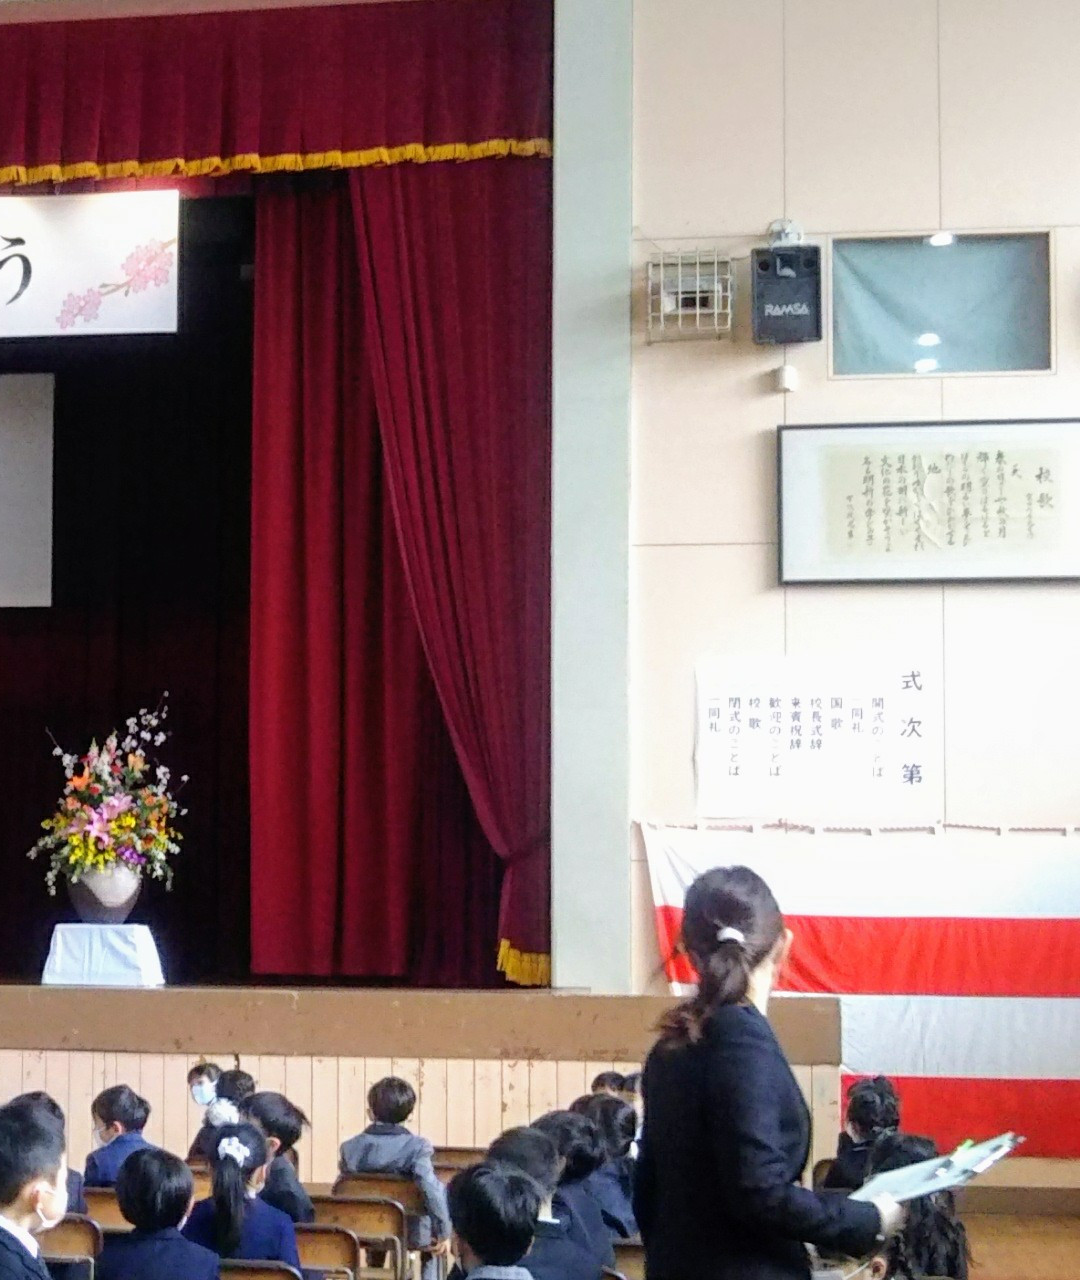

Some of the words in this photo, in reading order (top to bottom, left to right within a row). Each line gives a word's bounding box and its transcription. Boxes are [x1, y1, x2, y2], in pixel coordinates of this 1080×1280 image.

[764, 303, 809, 316] RAMSA
[1035, 466, 1053, 508] 校歌
[748, 697, 762, 729] 校歌
[810, 697, 822, 750] 校長式辞
[830, 697, 843, 729] 国歌
[900, 670, 923, 785] 式次第
[728, 697, 741, 777] 閉式のことば
